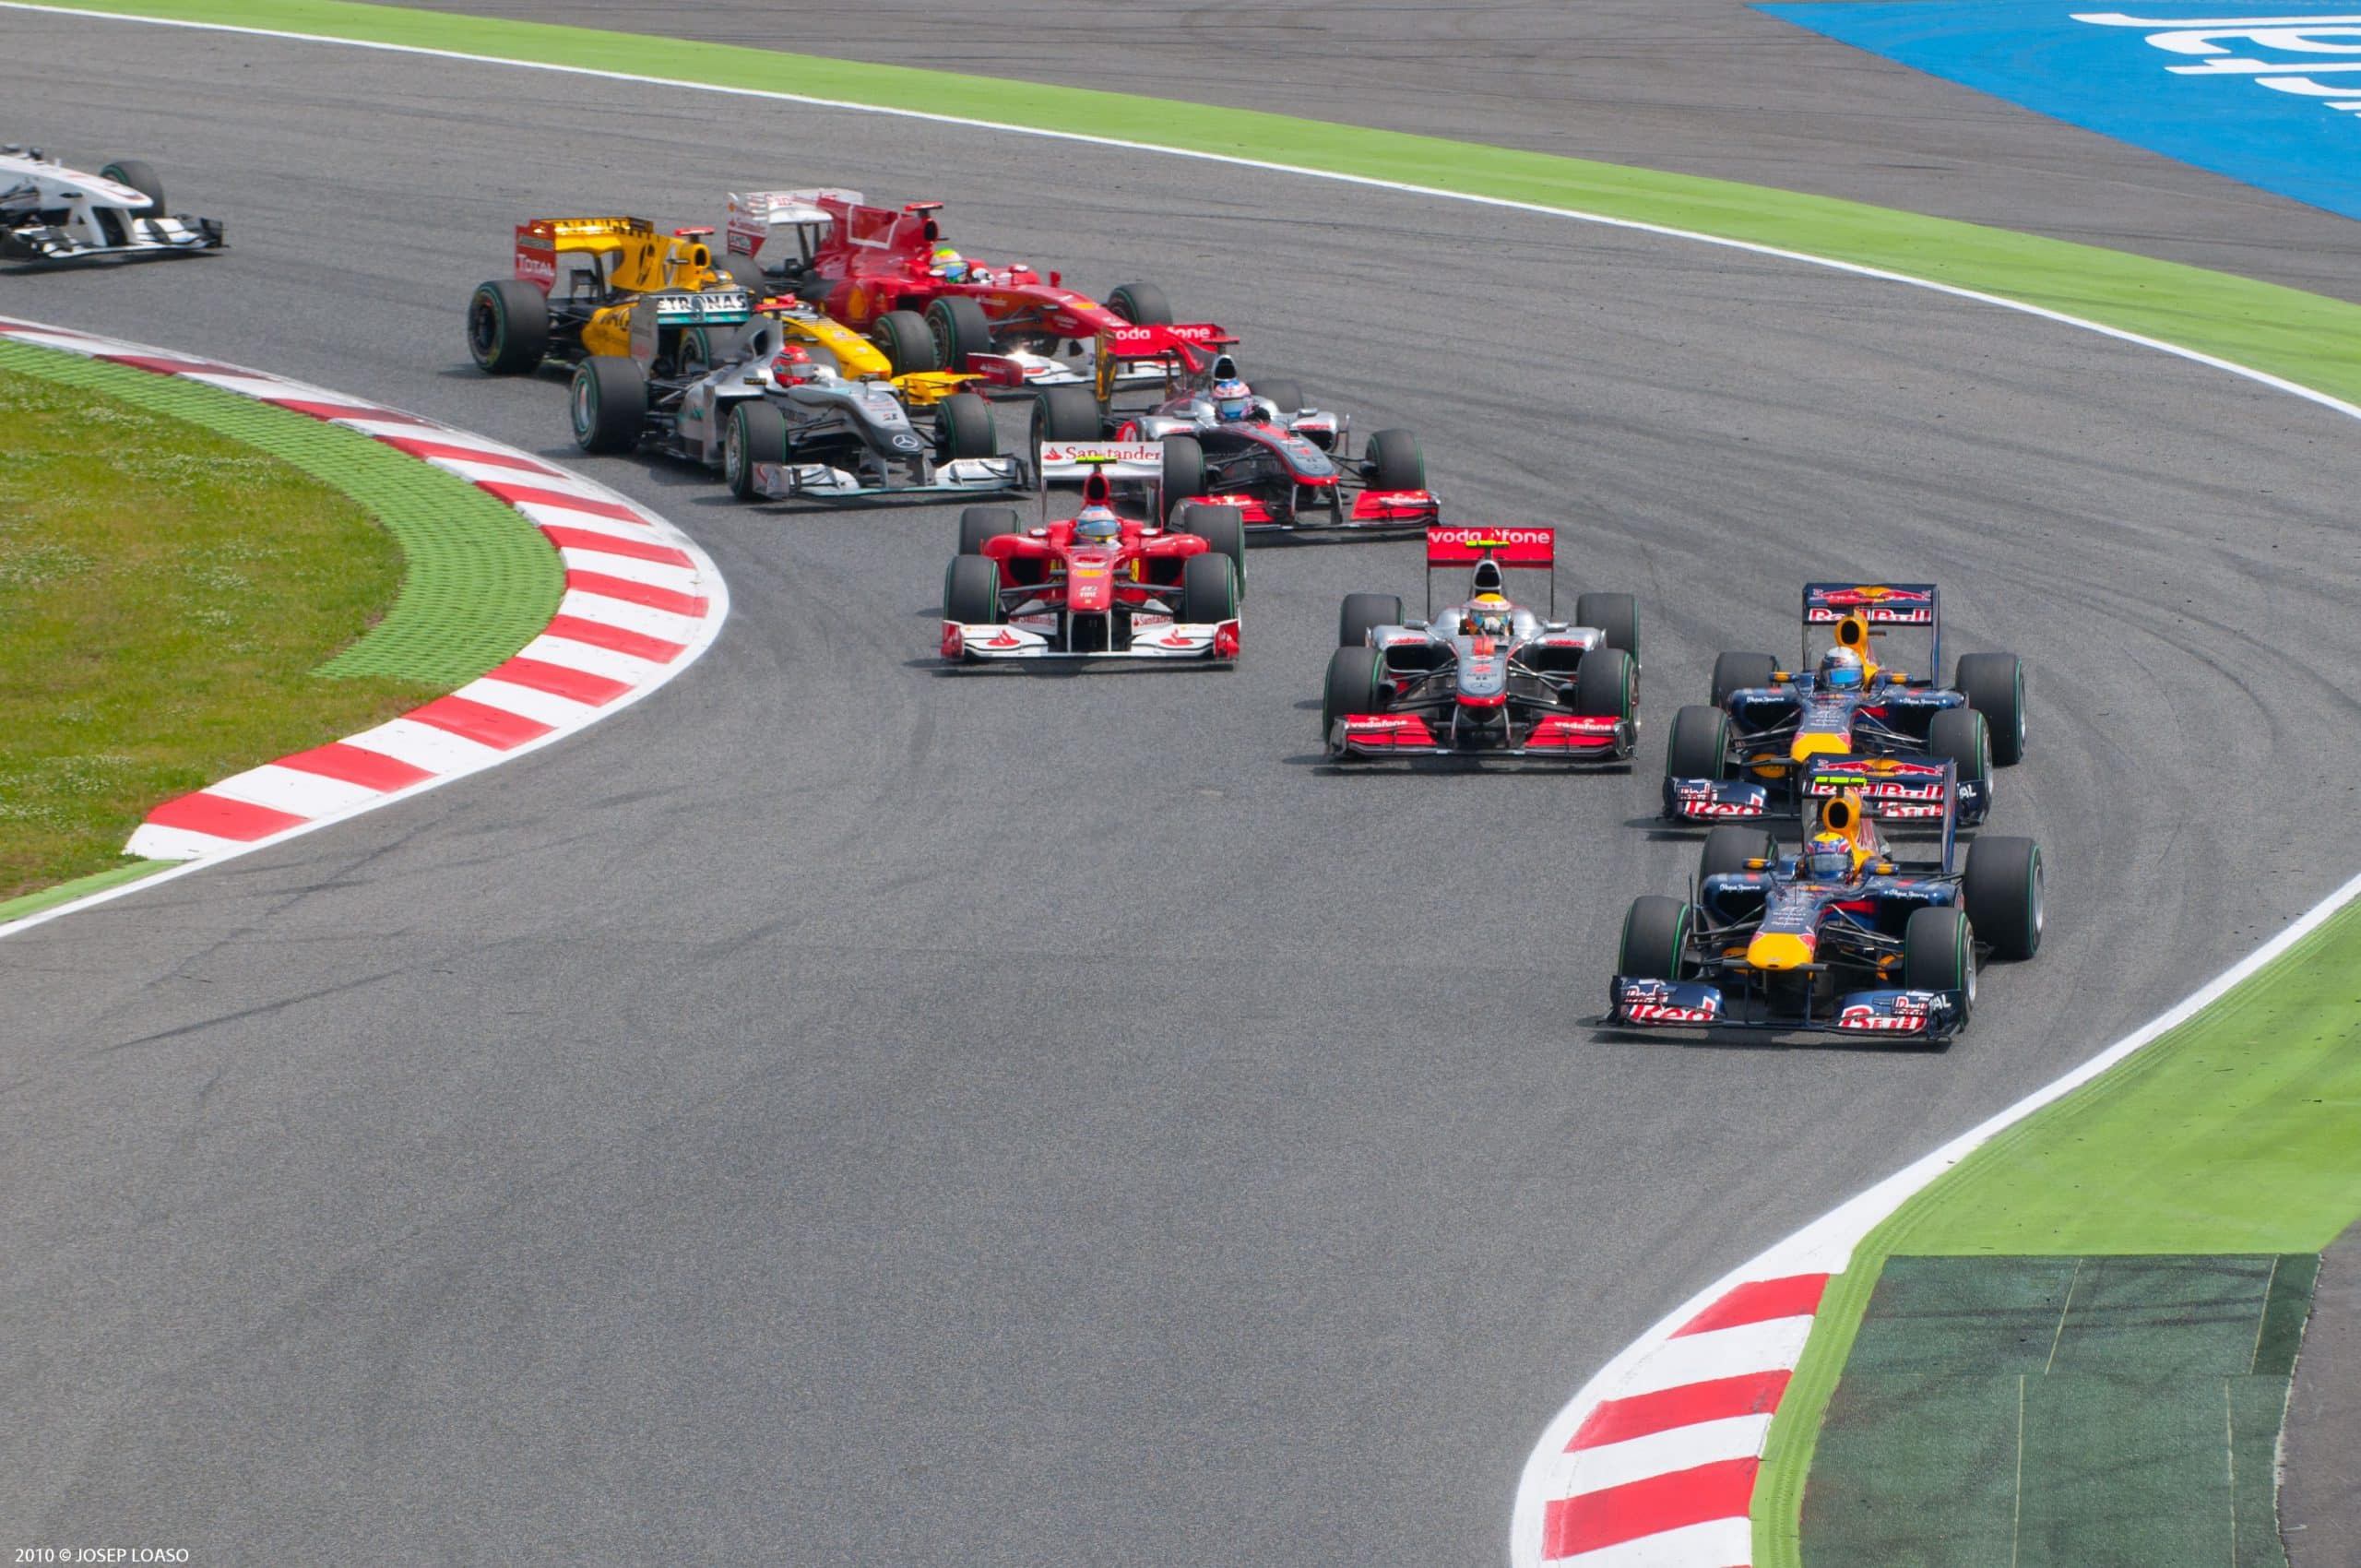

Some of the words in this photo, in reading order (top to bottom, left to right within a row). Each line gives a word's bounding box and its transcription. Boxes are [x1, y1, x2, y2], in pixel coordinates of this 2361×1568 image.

[516, 254, 555, 277] TOTAL
[657, 294, 746, 312] ETRONAS
[1429, 529, 1550, 544] vodafone
[1872, 608, 1933, 622] Bull
[1350, 719, 1409, 729] vodafone
[1553, 721, 1612, 731] vodafone
[1629, 996, 1716, 1021] Red
[1838, 1004, 1928, 1031] Bull
